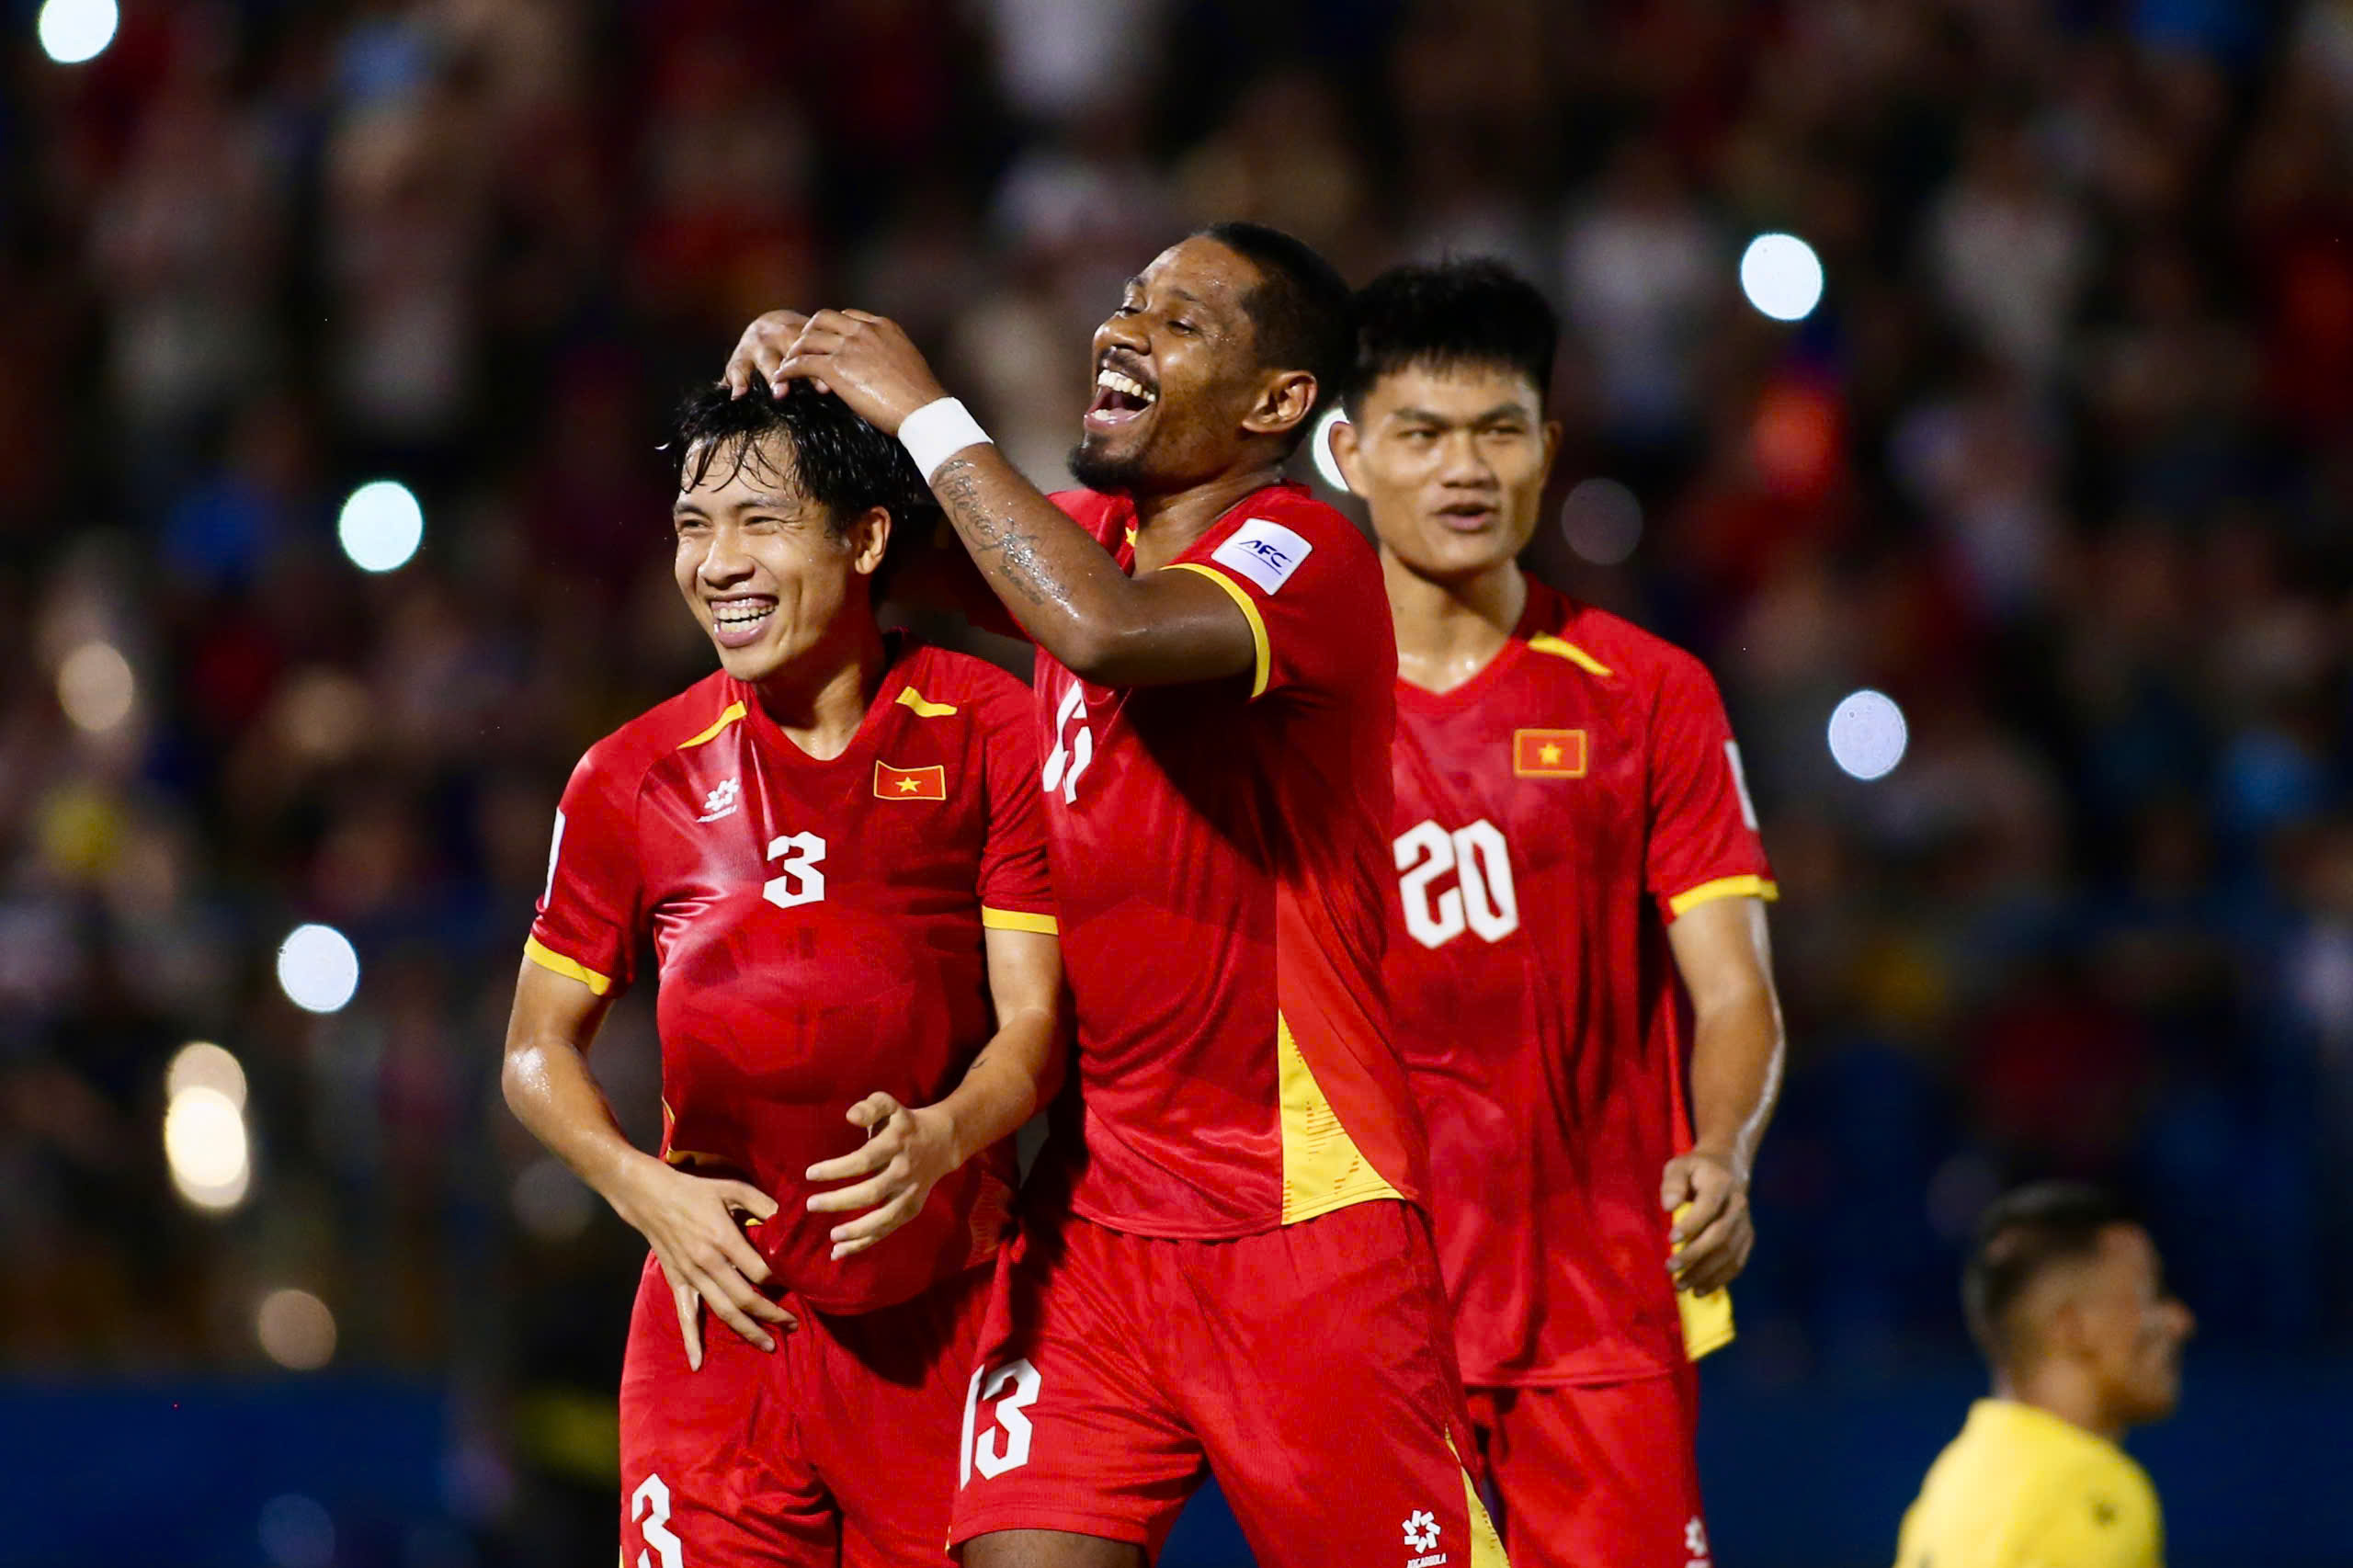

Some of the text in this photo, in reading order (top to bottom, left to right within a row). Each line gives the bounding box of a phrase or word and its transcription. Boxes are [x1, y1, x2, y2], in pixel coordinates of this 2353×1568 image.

[1237, 540, 1292, 568] AFC
[762, 831, 826, 909] 3
[1392, 819, 1518, 949] 20
[960, 1358, 1042, 1492] 13
[631, 1472, 684, 1568] 3
